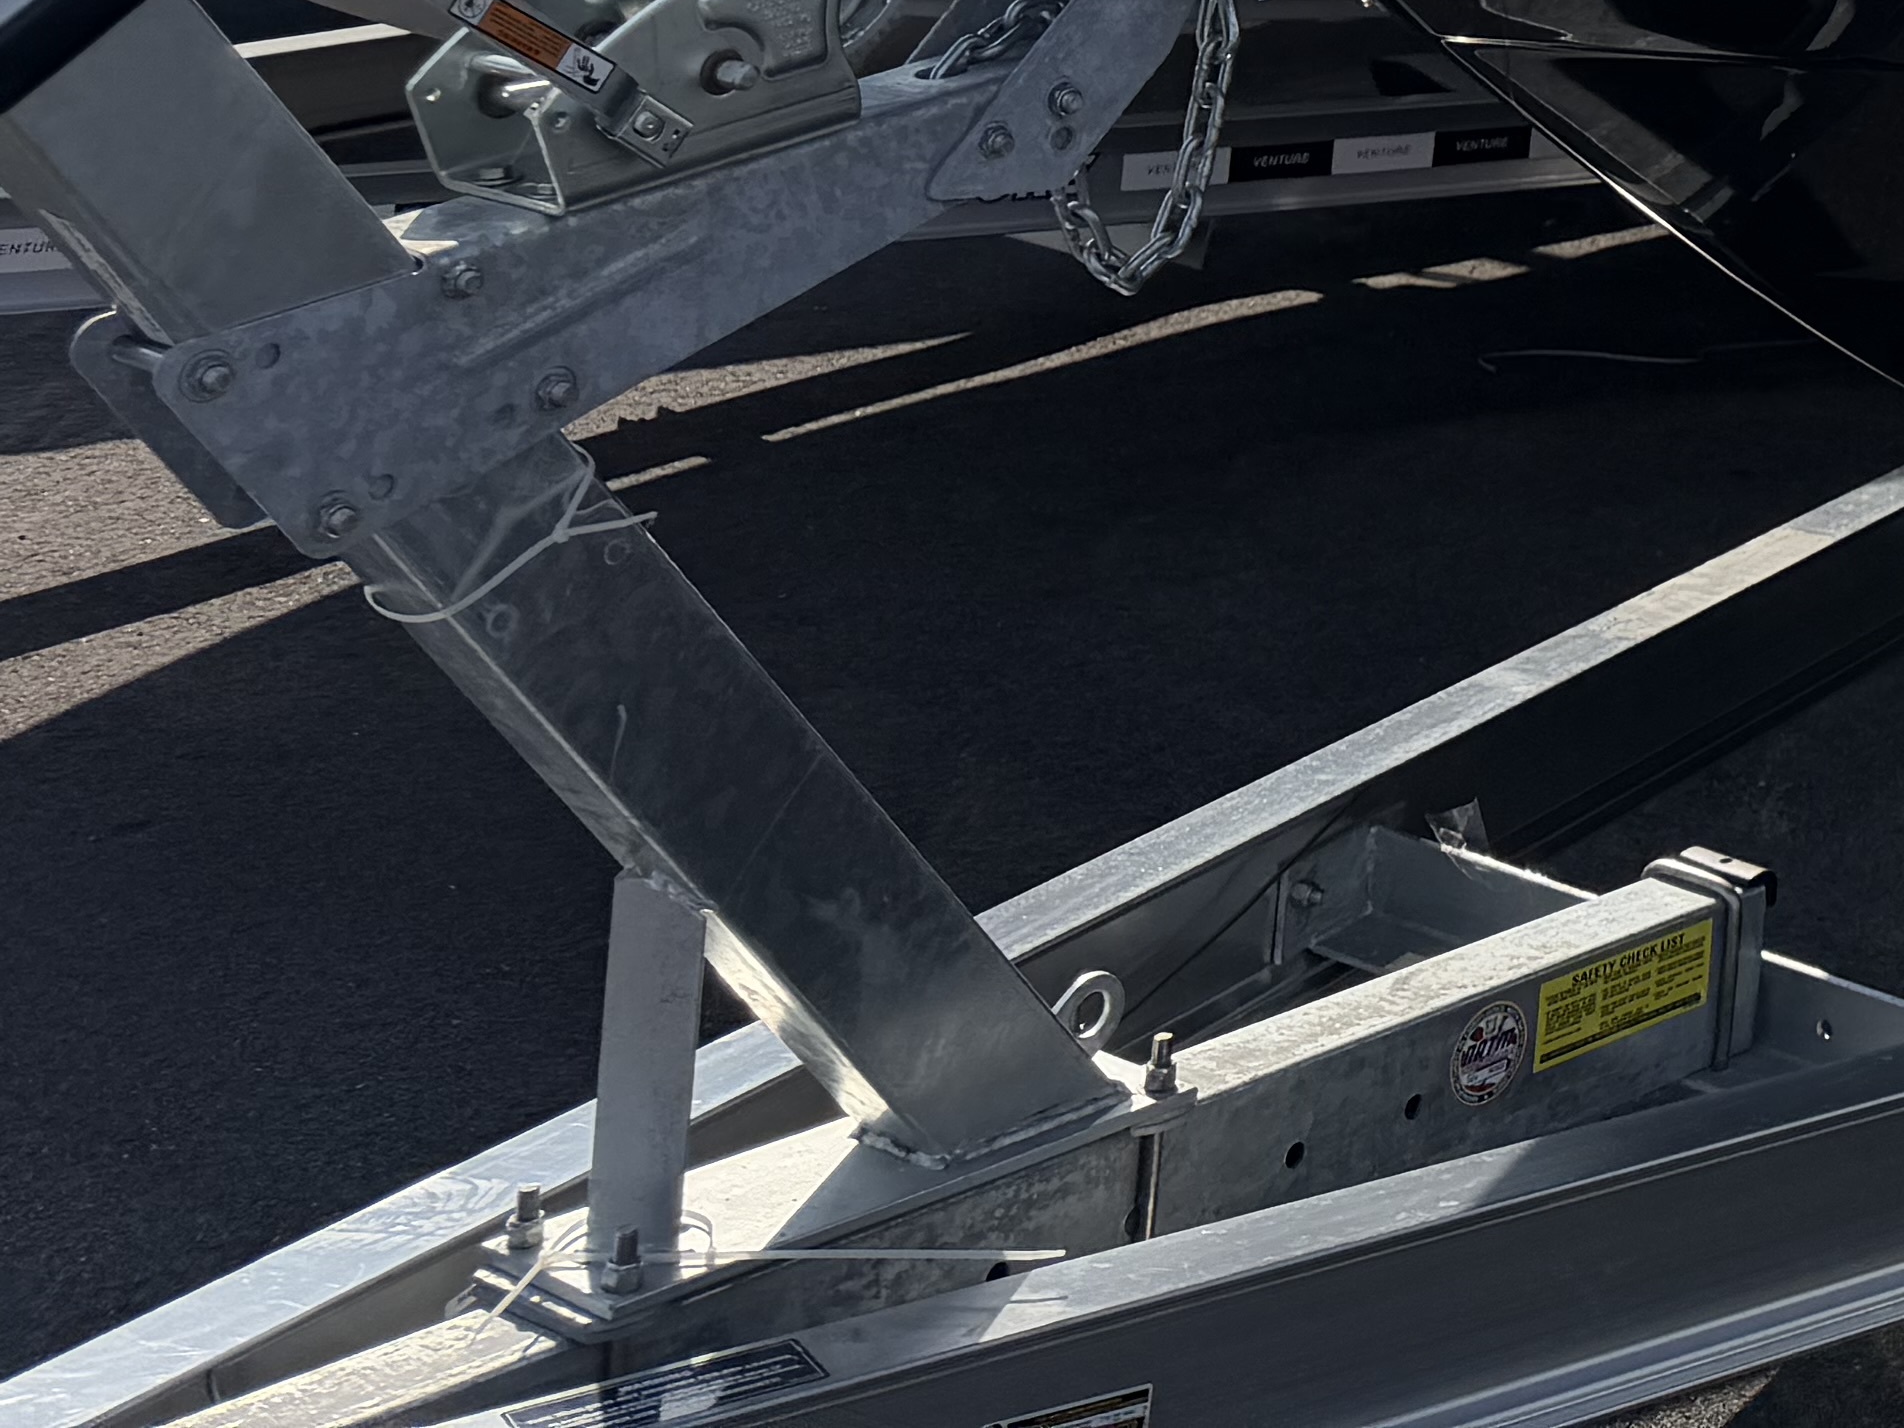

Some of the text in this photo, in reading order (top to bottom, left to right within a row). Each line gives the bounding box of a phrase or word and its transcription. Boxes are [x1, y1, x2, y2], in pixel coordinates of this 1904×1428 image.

[1456, 136, 1509, 151] VENTURE
[1253, 152, 1310, 168] VENTURE
[0, 241, 54, 255] ENTUR
[1572, 933, 1686, 984] SAFETY CHECK LIST
